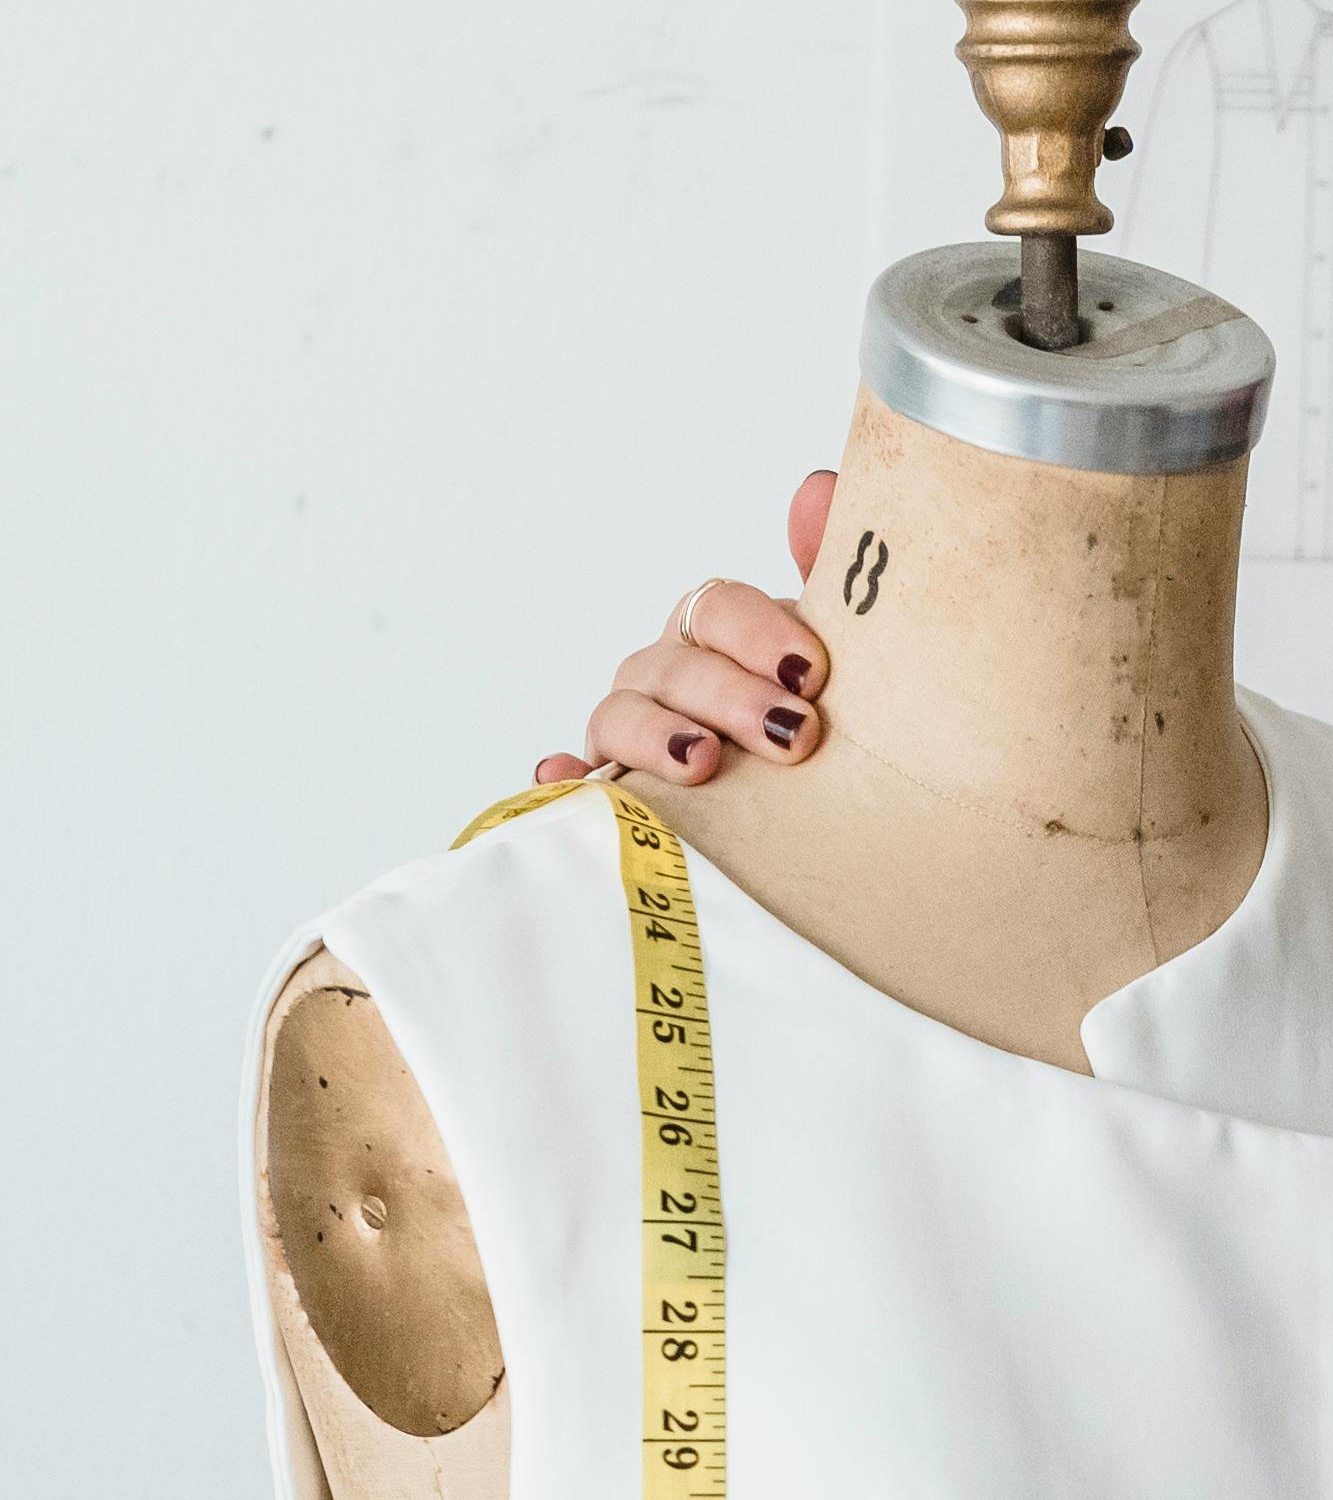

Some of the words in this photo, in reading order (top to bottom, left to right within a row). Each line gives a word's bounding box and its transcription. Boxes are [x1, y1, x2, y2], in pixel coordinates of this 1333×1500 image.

[843, 531, 889, 615] 8
[620, 798, 661, 849] 23
[638, 886, 676, 943] 24
[652, 983, 687, 1044] 25
[656, 1085, 692, 1147] 26
[661, 1189, 698, 1253] 27
[662, 1299, 699, 1362] 28
[663, 1408, 700, 1471] 29
